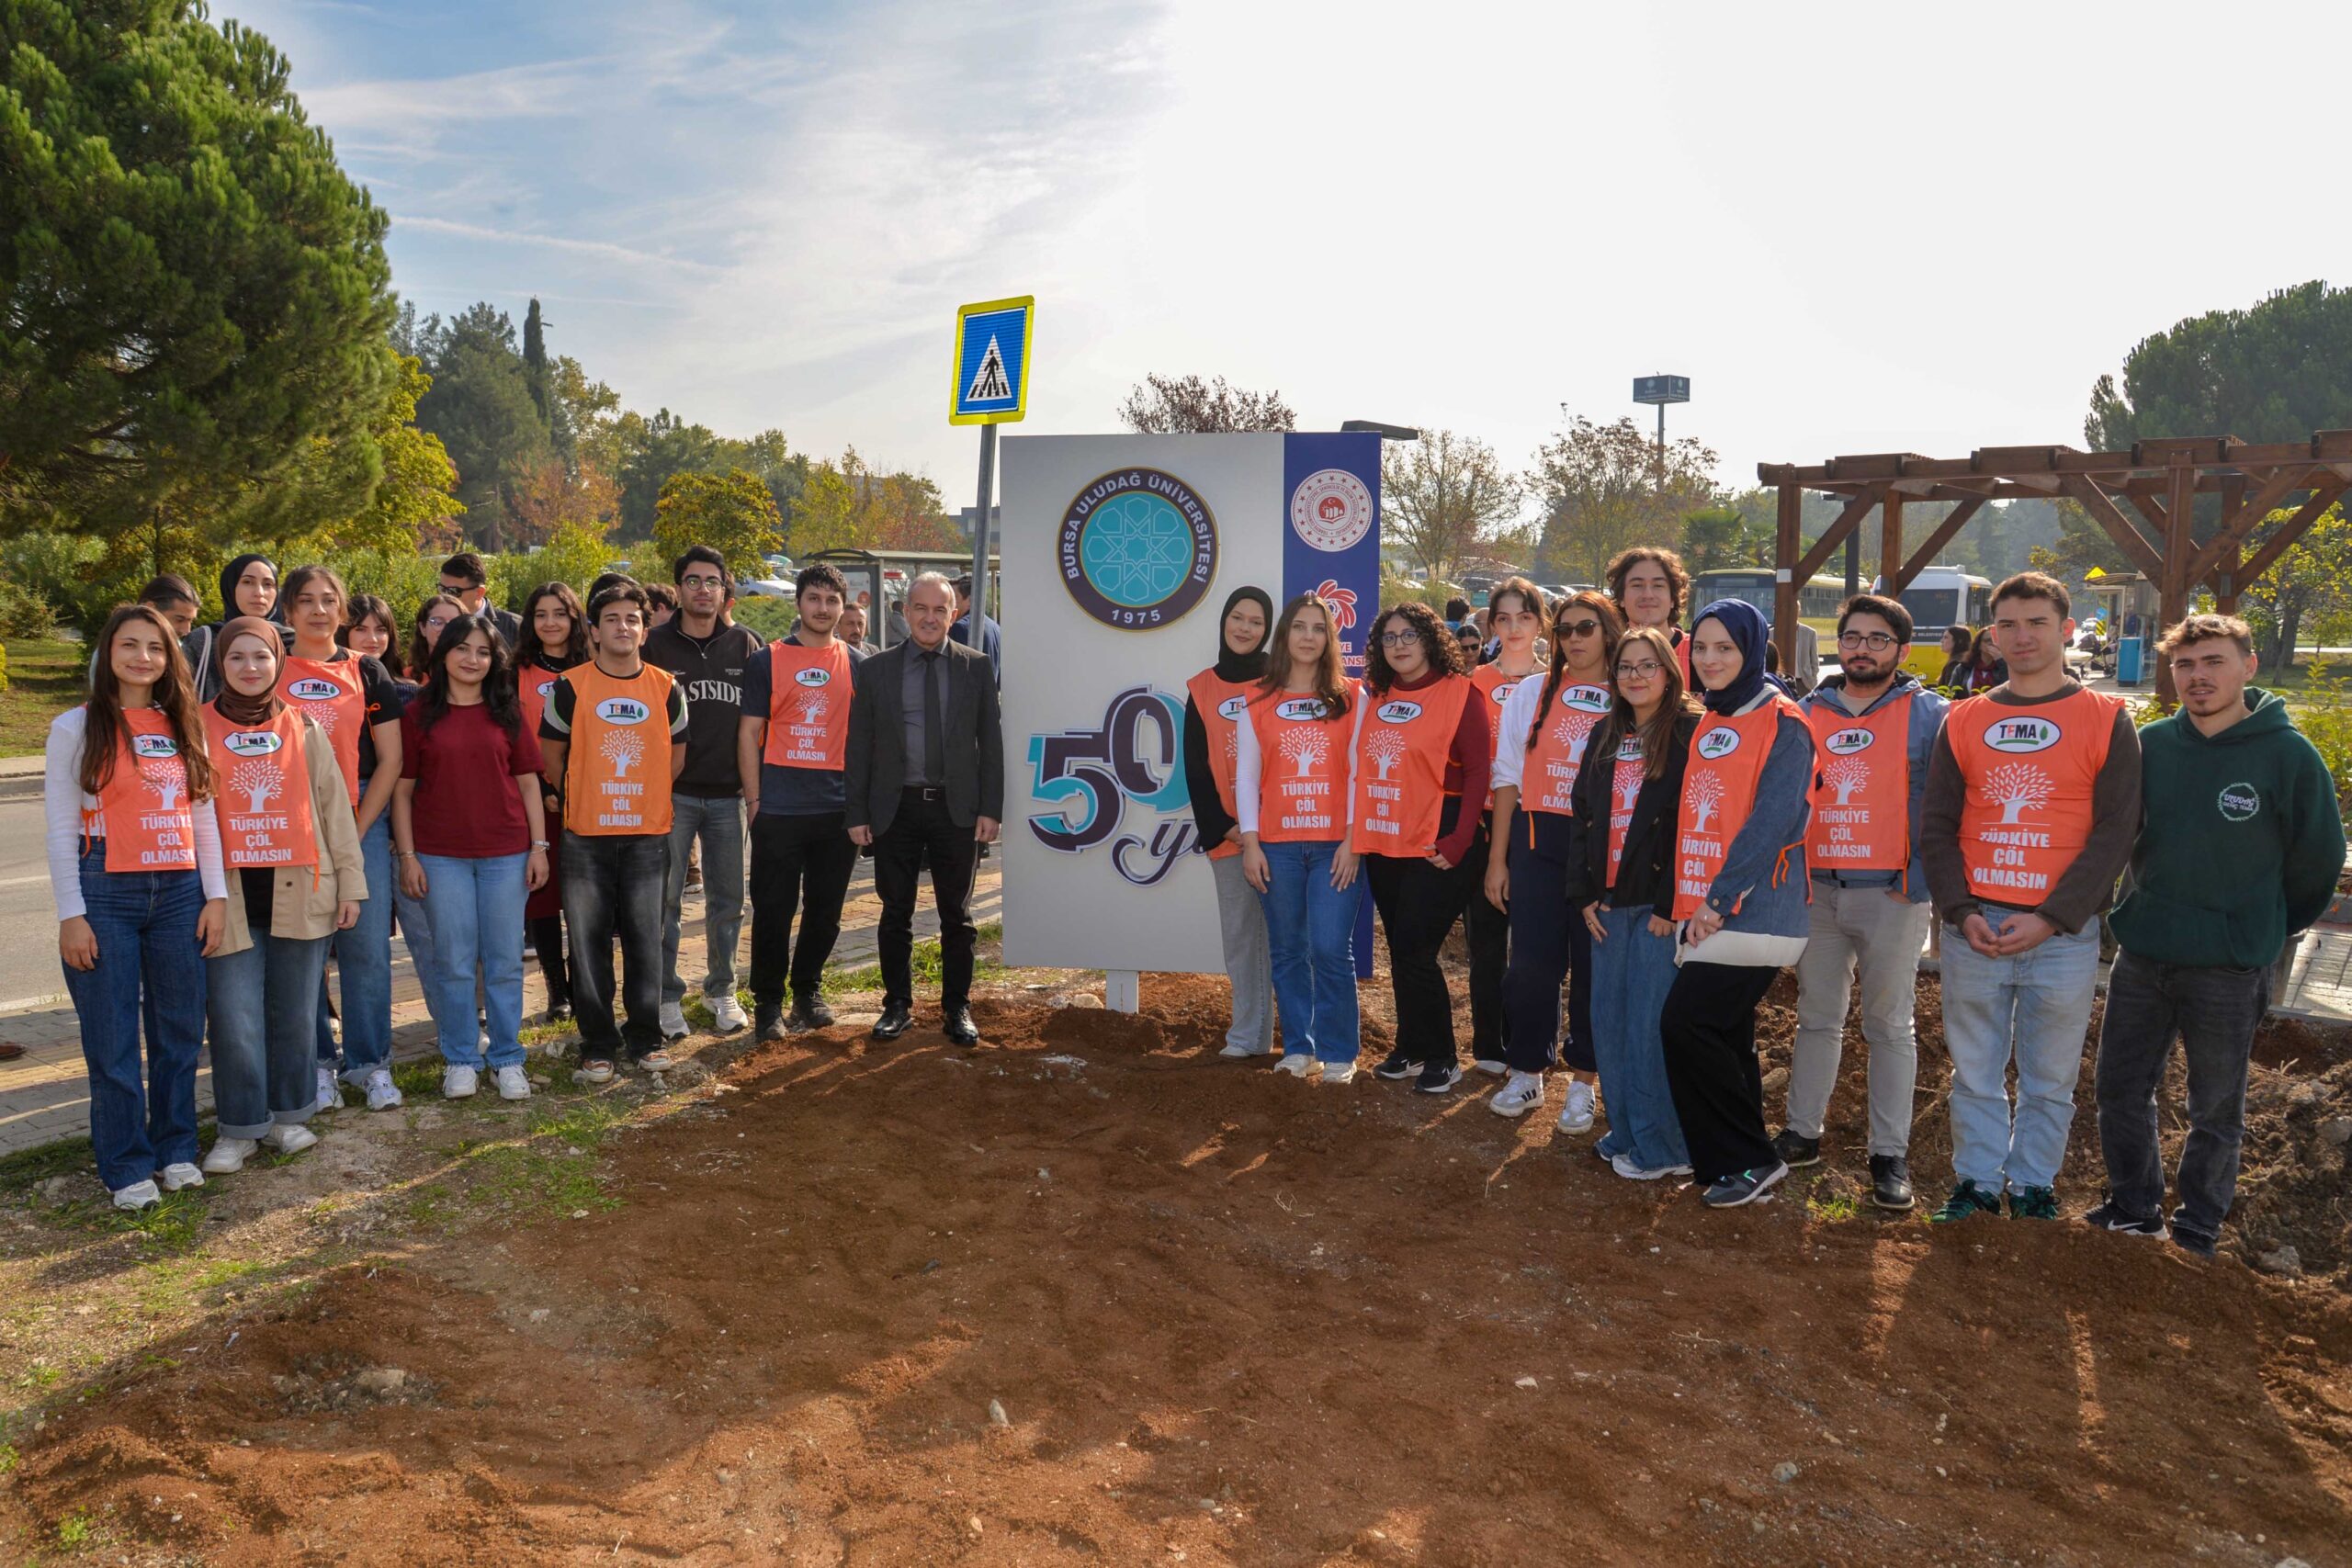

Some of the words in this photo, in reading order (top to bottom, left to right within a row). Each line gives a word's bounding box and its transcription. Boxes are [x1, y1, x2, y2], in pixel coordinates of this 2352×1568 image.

[1063, 519, 1081, 580] BURSA
[1075, 471, 1141, 514] ULUDAĞ
[1148, 473, 1213, 583] ÜNİVERSİTESİ
[1111, 609, 1161, 625] 1975
[803, 671, 822, 681] TEMA
[300, 682, 328, 693] TEMA
[1573, 689, 1601, 704] TEMA
[609, 704, 636, 715] TEMA
[1287, 702, 1314, 713] TEMA
[1387, 705, 1411, 716] TEMA
[789, 724, 827, 738] TÜRKİYE
[1999, 724, 2037, 739] TEMA
[141, 738, 169, 749] TEMA
[235, 734, 267, 746] TEMA
[798, 737, 816, 750] ÇÖL
[1707, 733, 1724, 747] TEMA
[1838, 733, 1860, 745] TEMA
[786, 750, 827, 761] OLMASIN
[1026, 684, 1192, 855] 50
[1545, 762, 1579, 780] TÜRK
[601, 780, 643, 795] TÜRKİYE
[1281, 779, 1330, 795] TÜRKİYE
[1366, 783, 1401, 801] TÜRKİYE
[1555, 779, 1574, 796] ÇÖ
[612, 796, 631, 813] ÇÖL
[1295, 796, 1317, 815] ÇÖL
[1543, 795, 1573, 809] OLMA
[229, 814, 289, 831] TÜRKİYE
[599, 814, 642, 827] OLMASIN
[1282, 815, 1331, 829] OLMASIN
[1818, 807, 1870, 824] TÜRKİYE
[157, 829, 184, 850] ÇÖL
[245, 831, 274, 850] ÇÖL
[1830, 824, 1854, 844] ÇÖL
[1979, 828, 2050, 848] TÜRKİYE
[1681, 834, 1723, 859] ÜRKİYE
[1817, 844, 1871, 858] OLMASIN
[231, 849, 292, 863] OLMASIN
[1993, 845, 2026, 868] ÇÖL
[1683, 857, 1706, 878] ÇÖL
[1973, 866, 2048, 890] OLMASIN
